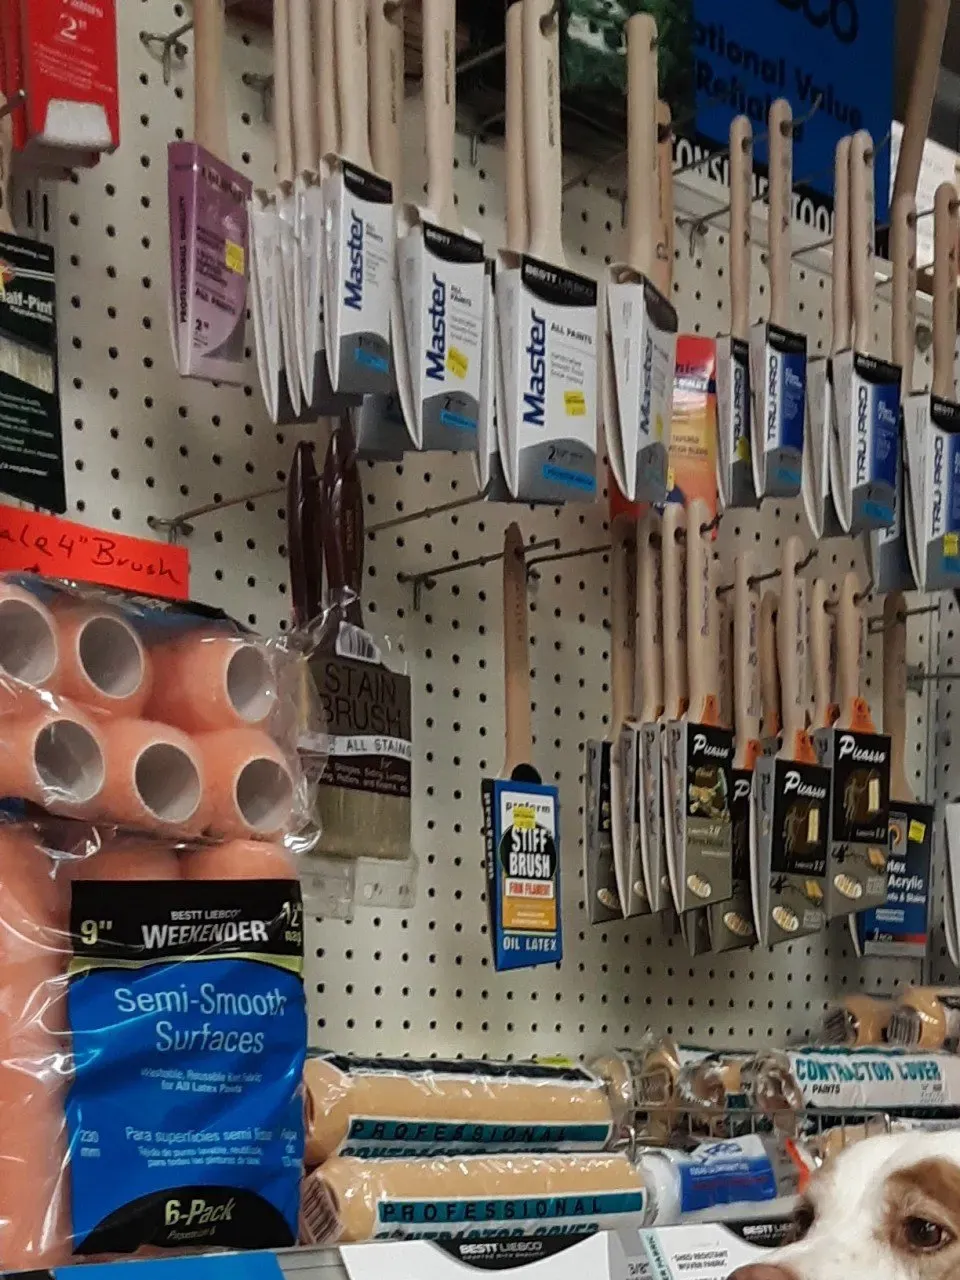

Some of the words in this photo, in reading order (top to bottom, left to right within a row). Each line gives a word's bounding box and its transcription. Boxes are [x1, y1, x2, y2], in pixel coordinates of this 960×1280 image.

[343, 208, 364, 312] Master
[425, 271, 447, 382] Master
[523, 306, 547, 428] Master
[767, 354, 779, 441] TRU-PRO
[856, 385, 869, 483] TRU-PRO
[931, 436, 945, 538] TRU-PRO
[0, 524, 53, 557] ale
[91, 536, 183, 586] Brush
[324, 662, 397, 707] STAIN
[320, 693, 402, 737] BRUSH
[346, 740, 368, 752] ALL
[374, 736, 412, 757] STAINS
[839, 734, 887, 763] Picasso
[783, 770, 827, 798] Picasso
[511, 827, 548, 853] STIFF
[509, 852, 550, 879] BRUSH
[171, 910, 202, 921] BESTT
[80, 918, 113, 945] 9"
[141, 919, 270, 950] WEEKENDER
[503, 936, 521, 951] OIL
[525, 937, 557, 952] LATEX
[113, 983, 288, 1017] Semi-Smooth
[155, 1020, 265, 1054] Surfaces
[796, 1057, 894, 1081] CONTRACTOR
[898, 1060, 942, 1081] COVER
[350, 1121, 566, 1144] PROFESSIONAL
[164, 1197, 236, 1226] 6-Pack
[382, 1195, 601, 1222] PROFESSIONAL
[459, 1243, 498, 1255] BESTT
[499, 1241, 543, 1253] LIEBCO
